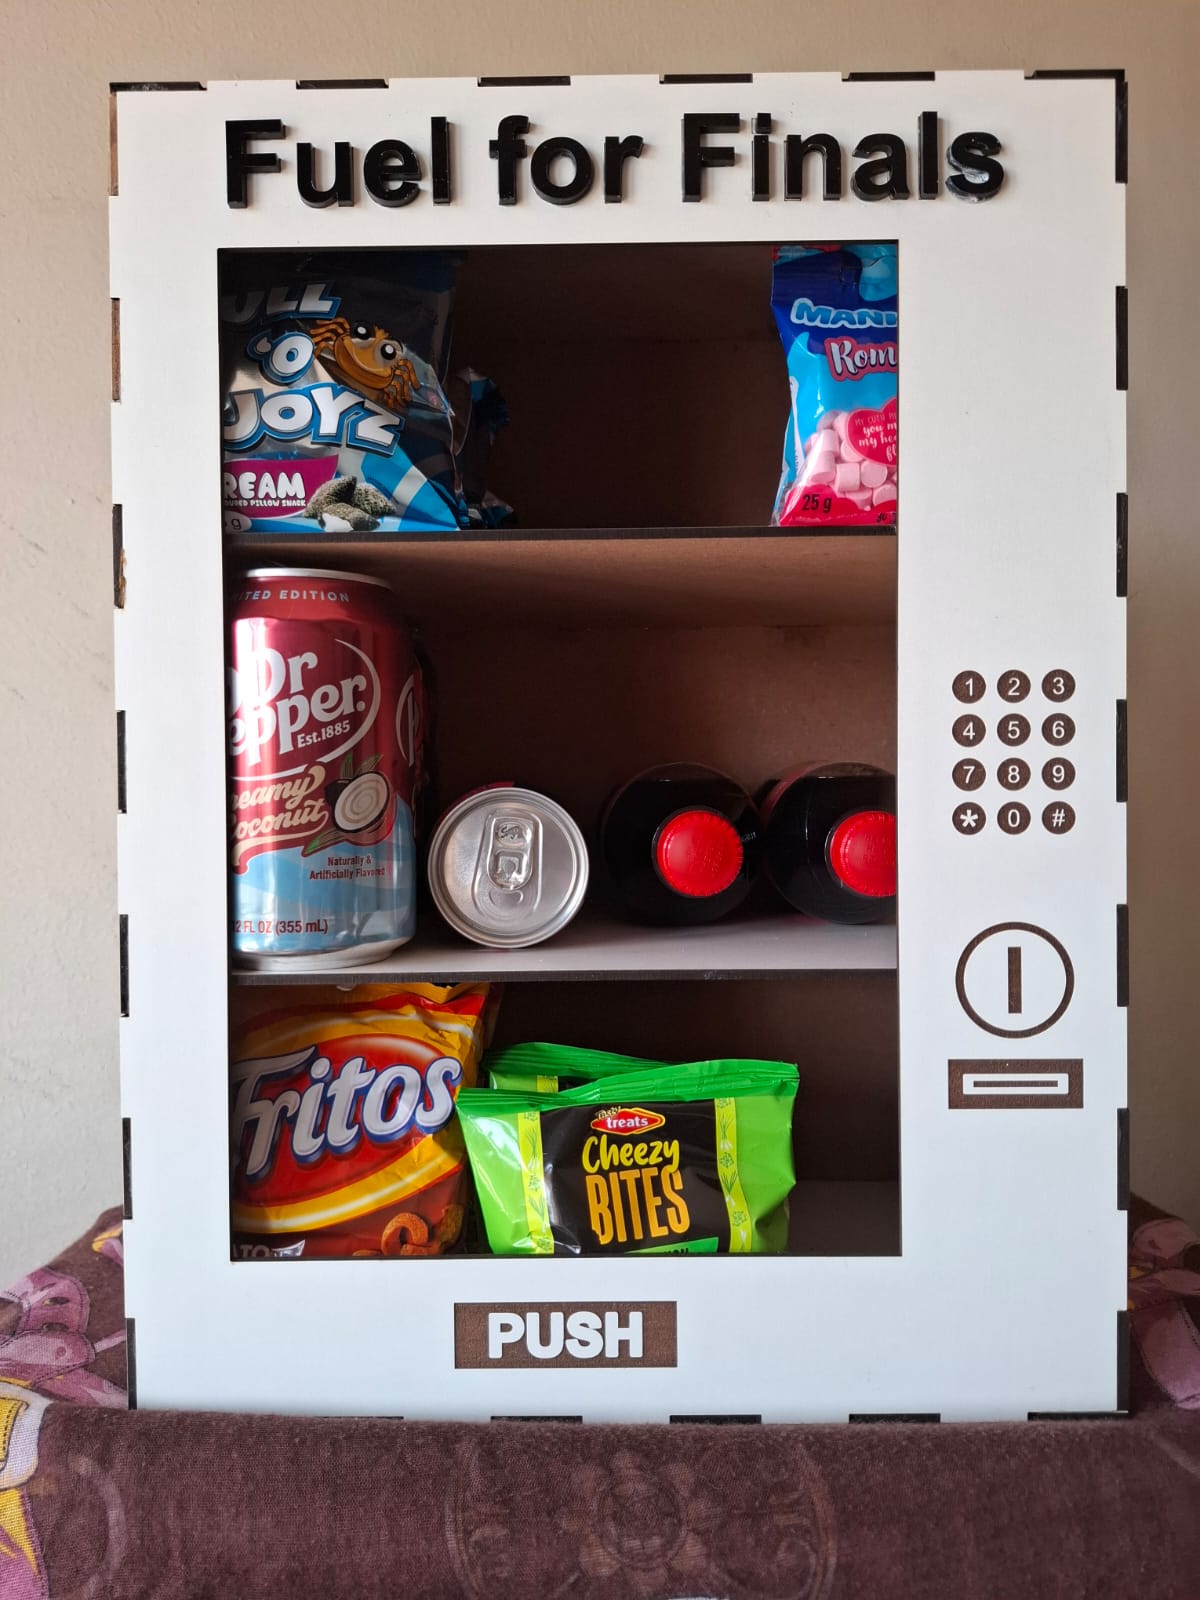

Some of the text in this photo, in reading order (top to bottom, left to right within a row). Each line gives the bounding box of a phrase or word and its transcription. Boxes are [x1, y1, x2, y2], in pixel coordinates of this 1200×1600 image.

[226, 110, 1003, 209] Fuel for Finals
[863, 425, 882, 438] you
[858, 437, 877, 449] my
[802, 494, 832, 514] 25 g
[279, 589, 350, 602] EDITION
[236, 646, 318, 704] Dr
[965, 676, 1064, 697] 1 2 3
[962, 720, 1065, 740] 4 5 6
[963, 764, 1065, 784] 7 8 9
[1007, 809, 1020, 828] 0
[327, 855, 371, 868] Naturally &
[309, 868, 354, 881] Artificially
[244, 920, 256, 933] FL
[258, 920, 272, 934] OZ
[275, 919, 302, 936] (355
[305, 919, 328, 935] mL)
[232, 1045, 462, 1179] Fritos
[606, 1116, 648, 1129] treats
[581, 1134, 680, 1174] Cheezy
[585, 1167, 691, 1245] BITES
[488, 1310, 643, 1359] PUSH
